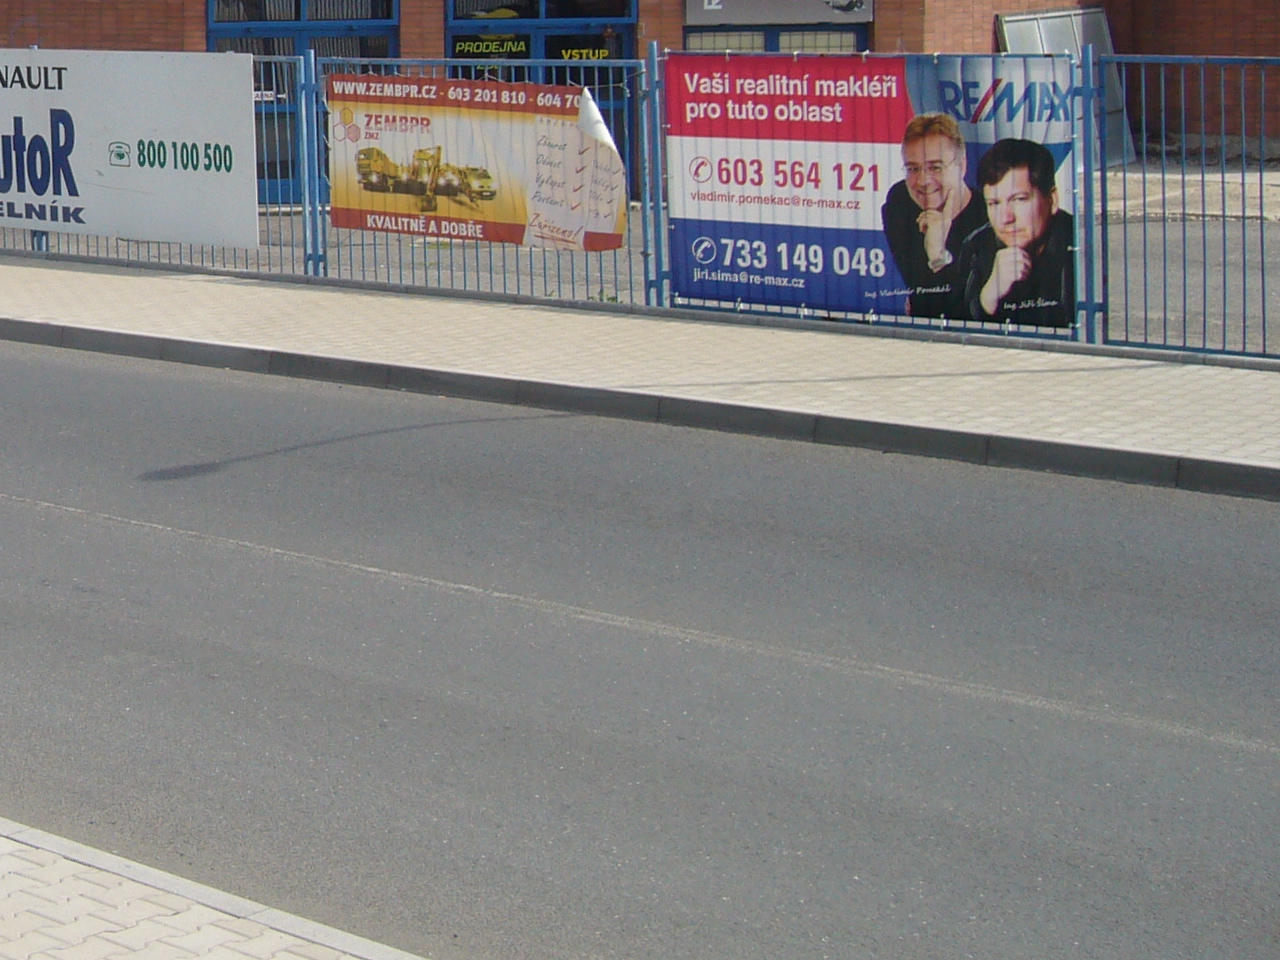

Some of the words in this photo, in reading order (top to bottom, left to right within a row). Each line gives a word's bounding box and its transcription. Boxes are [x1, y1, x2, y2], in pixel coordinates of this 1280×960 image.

[455, 41, 526, 54] PRODEJNA
[561, 49, 609, 60] VSTUP
[332, 80, 436, 100] WWW.ZEMBPR.CZ
[447, 87, 471, 102] 603
[474, 88, 498, 103] 201
[501, 90, 526, 105] 810
[536, 92, 561, 108] 604
[684, 72, 729, 94] Vaši
[736, 74, 809, 96] realitní
[815, 75, 898, 98] makléři
[685, 102, 721, 123] pro
[727, 100, 768, 120] tuto
[774, 101, 843, 123] oblast
[938, 78, 1074, 124] RE/MAX
[364, 113, 431, 134] ZEMBPR
[136, 139, 167, 170] 800
[172, 141, 200, 172] 100
[203, 142, 233, 173] 500
[717, 157, 764, 187] 603
[774, 160, 821, 190] 564
[832, 162, 879, 191] 121
[690, 190, 861, 210] vladimir.pomekac@re-max.cz
[367, 214, 426, 233] KVALITNĚ
[428, 220, 438, 234] A
[441, 220, 484, 238] DOBŘE
[720, 238, 768, 269] 733
[776, 242, 823, 274] 149
[832, 246, 886, 278] 048
[693, 268, 805, 288] jiri.sima@re-max.cz
